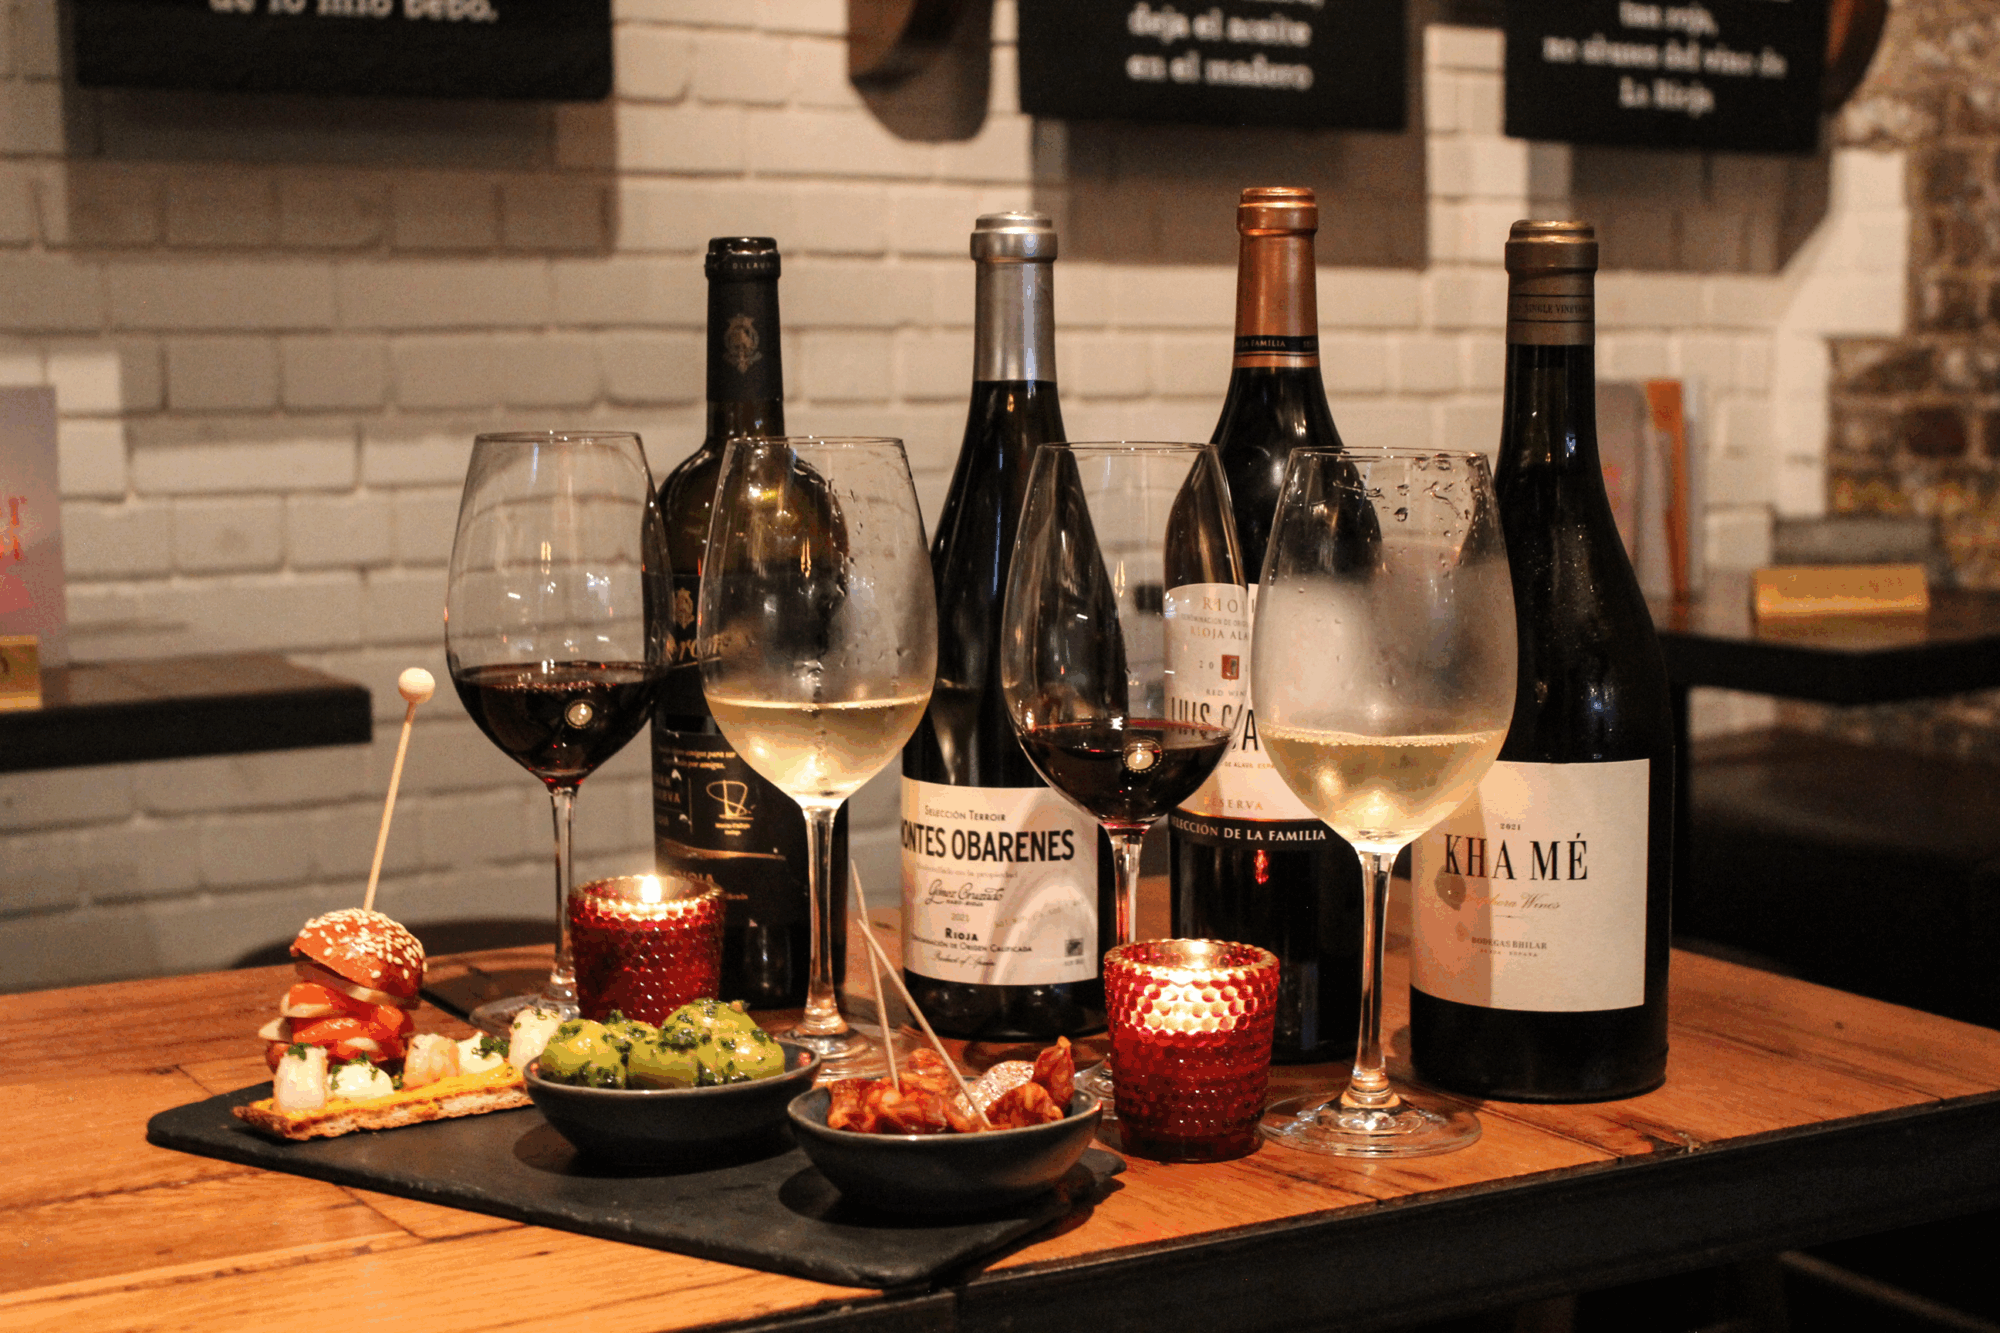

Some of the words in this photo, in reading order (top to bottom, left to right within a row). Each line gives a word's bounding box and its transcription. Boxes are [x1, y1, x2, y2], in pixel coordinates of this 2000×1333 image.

[403, 0, 498, 23] bebo.
[1193, 7, 1225, 42] el
[1703, 42, 1754, 76] vino
[1170, 51, 1200, 84] el
[1205, 53, 1314, 91] madero
[1620, 76, 1648, 109] La
[1653, 78, 1715, 118] Rioja
[1251, 339, 1286, 348] FAMILIA
[1190, 626, 1224, 640] RIOJA
[1206, 688, 1224, 697] RED
[1228, 689, 1247, 697] WIN
[1203, 794, 1263, 811] RESERVA
[1171, 816, 1219, 837] ELECCIÓN
[1224, 827, 1242, 840] DE
[1246, 829, 1263, 841] LA
[1268, 829, 1327, 842] FAMILIA
[1500, 823, 1521, 831] 2021
[901, 819, 946, 858] ONTES
[952, 828, 1075, 863] OBARENES
[1444, 833, 1517, 881] KHA
[1529, 832, 1588, 881] MÉ
[1521, 891, 1561, 910] Wines
[945, 927, 979, 942] RIOJA
[1472, 936, 1511, 949] BODEGAS
[1512, 940, 1548, 950] BHILAR
[960, 941, 988, 952] ORIGEN
[990, 943, 1033, 953] CALIFICADA
